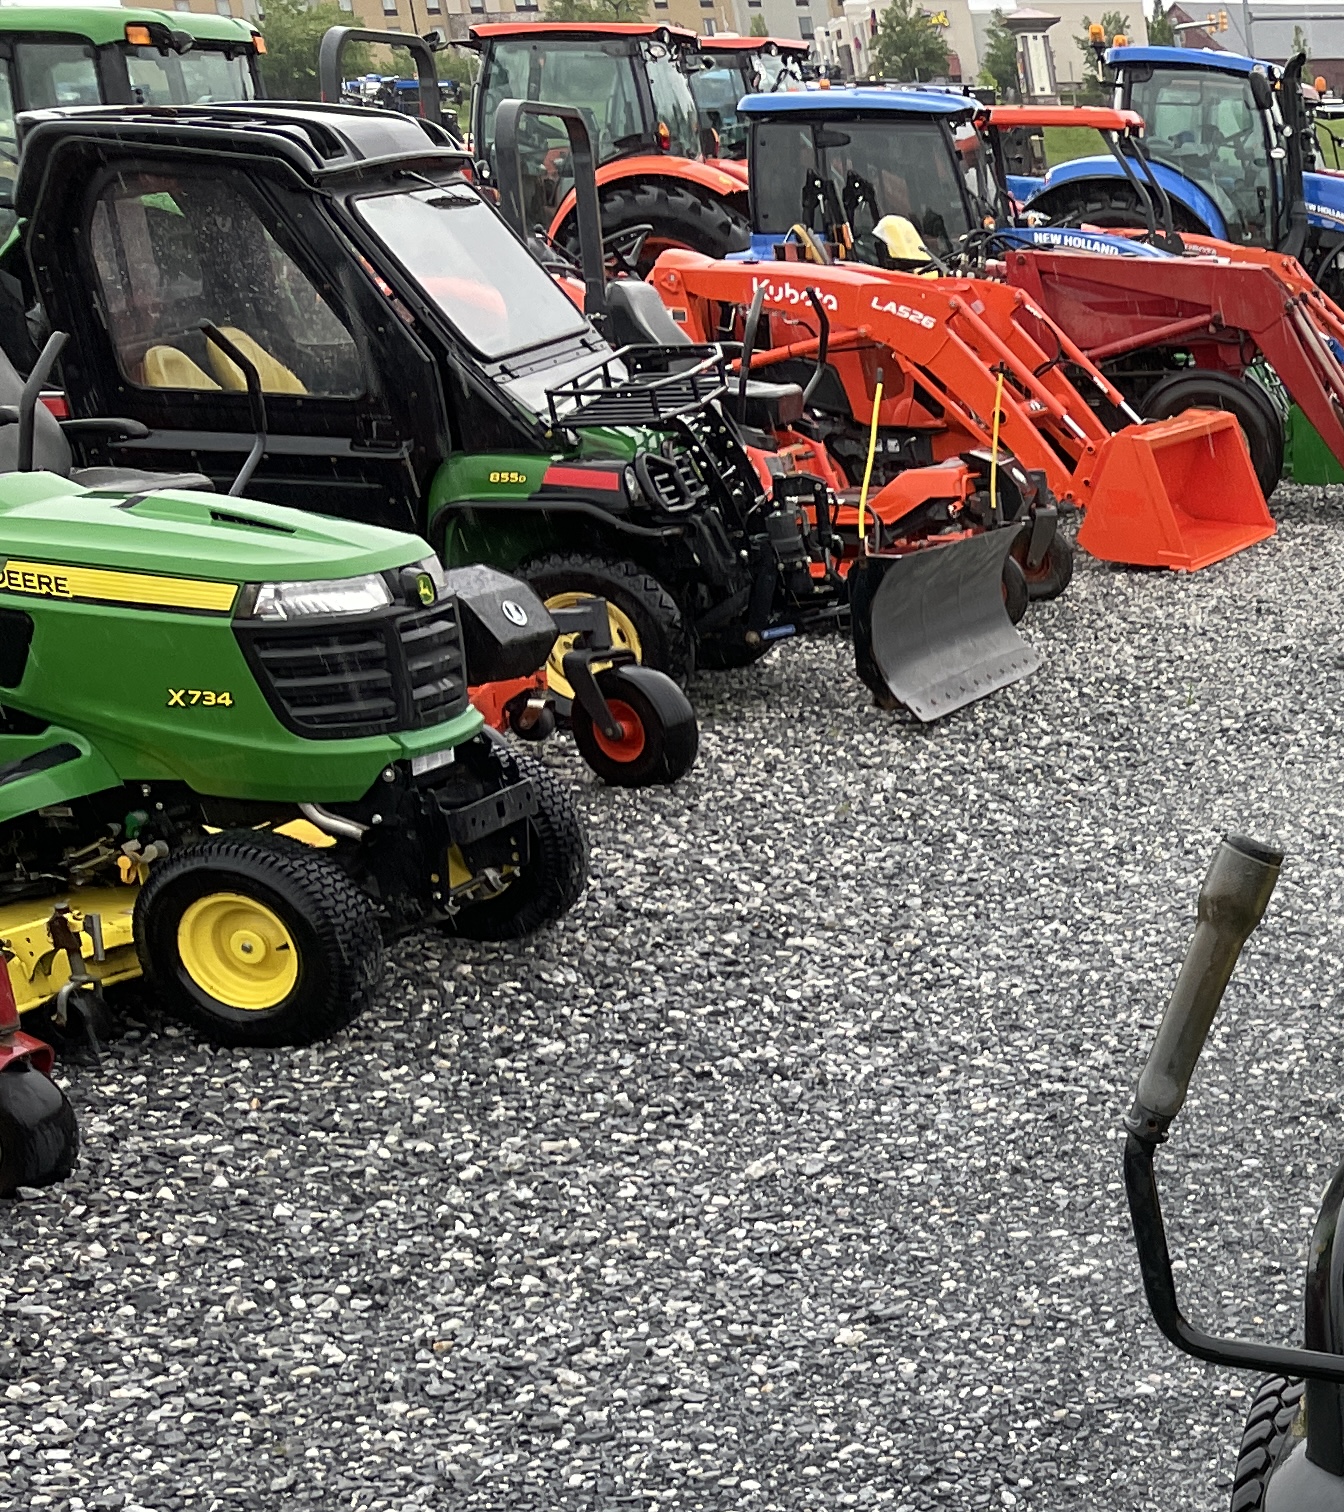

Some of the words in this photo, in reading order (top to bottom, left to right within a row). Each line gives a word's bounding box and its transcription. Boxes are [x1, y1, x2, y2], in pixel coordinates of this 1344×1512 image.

[1033, 231, 1062, 245] NEW
[1063, 235, 1119, 255] HOLLAND
[752, 276, 838, 311] Kubota
[870, 296, 937, 330] LA526
[0, 568, 71, 595] EERE
[166, 688, 233, 708] X734
